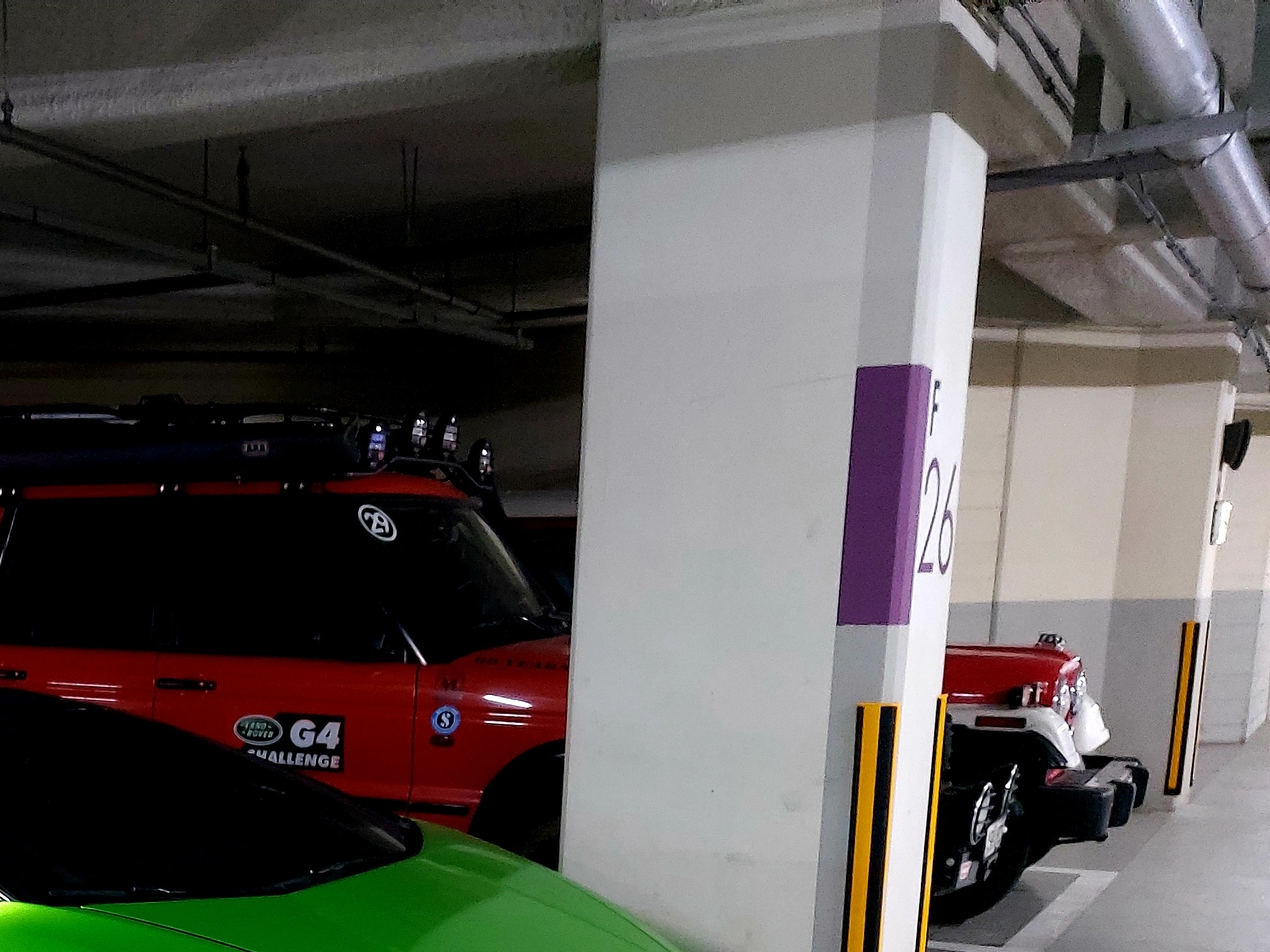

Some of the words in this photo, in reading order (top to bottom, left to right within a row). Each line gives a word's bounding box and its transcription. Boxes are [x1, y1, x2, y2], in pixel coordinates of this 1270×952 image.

[929, 379, 941, 436] F
[363, 511, 390, 534] 29
[917, 457, 957, 574] 26
[289, 719, 342, 750] G4
